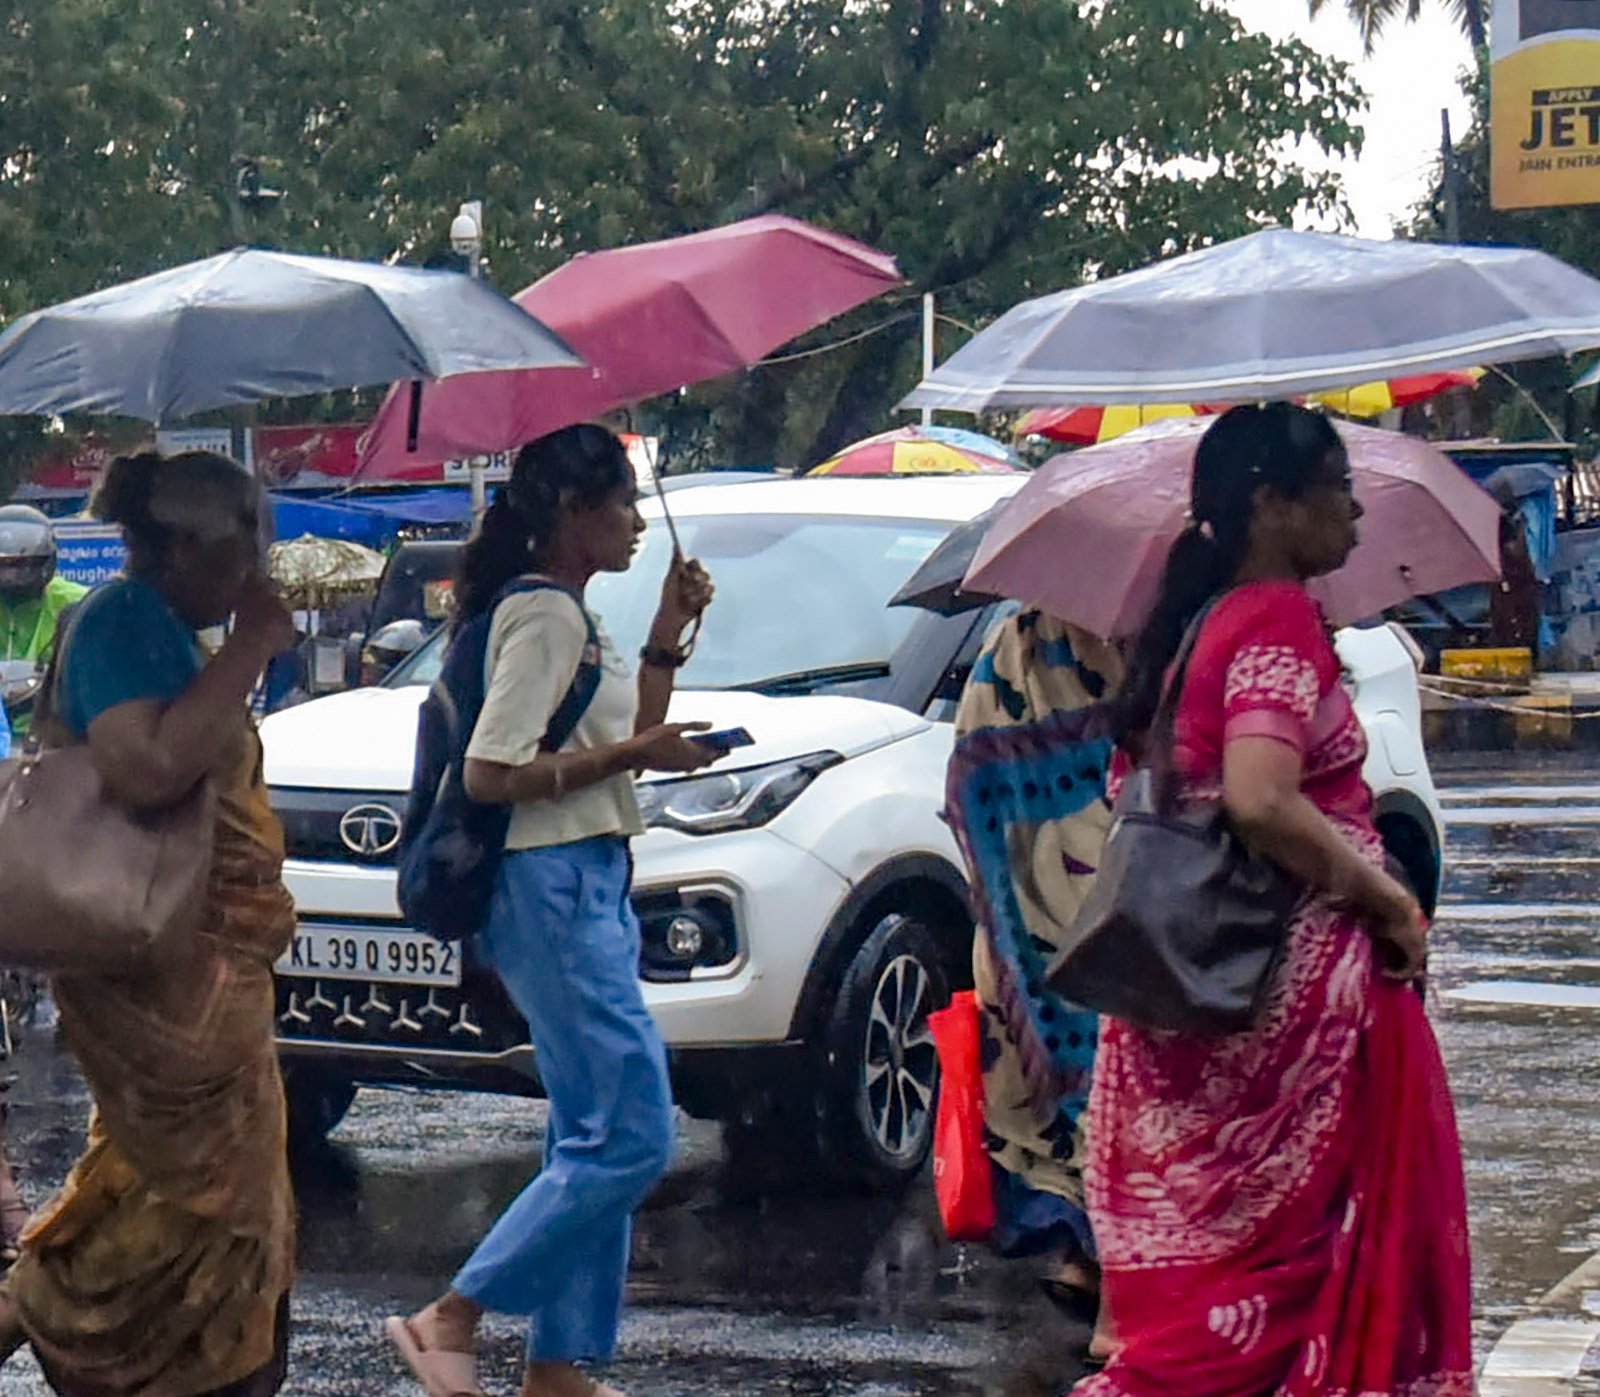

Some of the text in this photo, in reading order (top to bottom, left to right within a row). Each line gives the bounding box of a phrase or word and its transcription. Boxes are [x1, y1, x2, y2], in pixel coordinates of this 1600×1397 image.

[1519, 107, 1600, 150] JET
[290, 935, 321, 968] KL
[327, 937, 358, 970] 39
[387, 940, 454, 976] 9952
